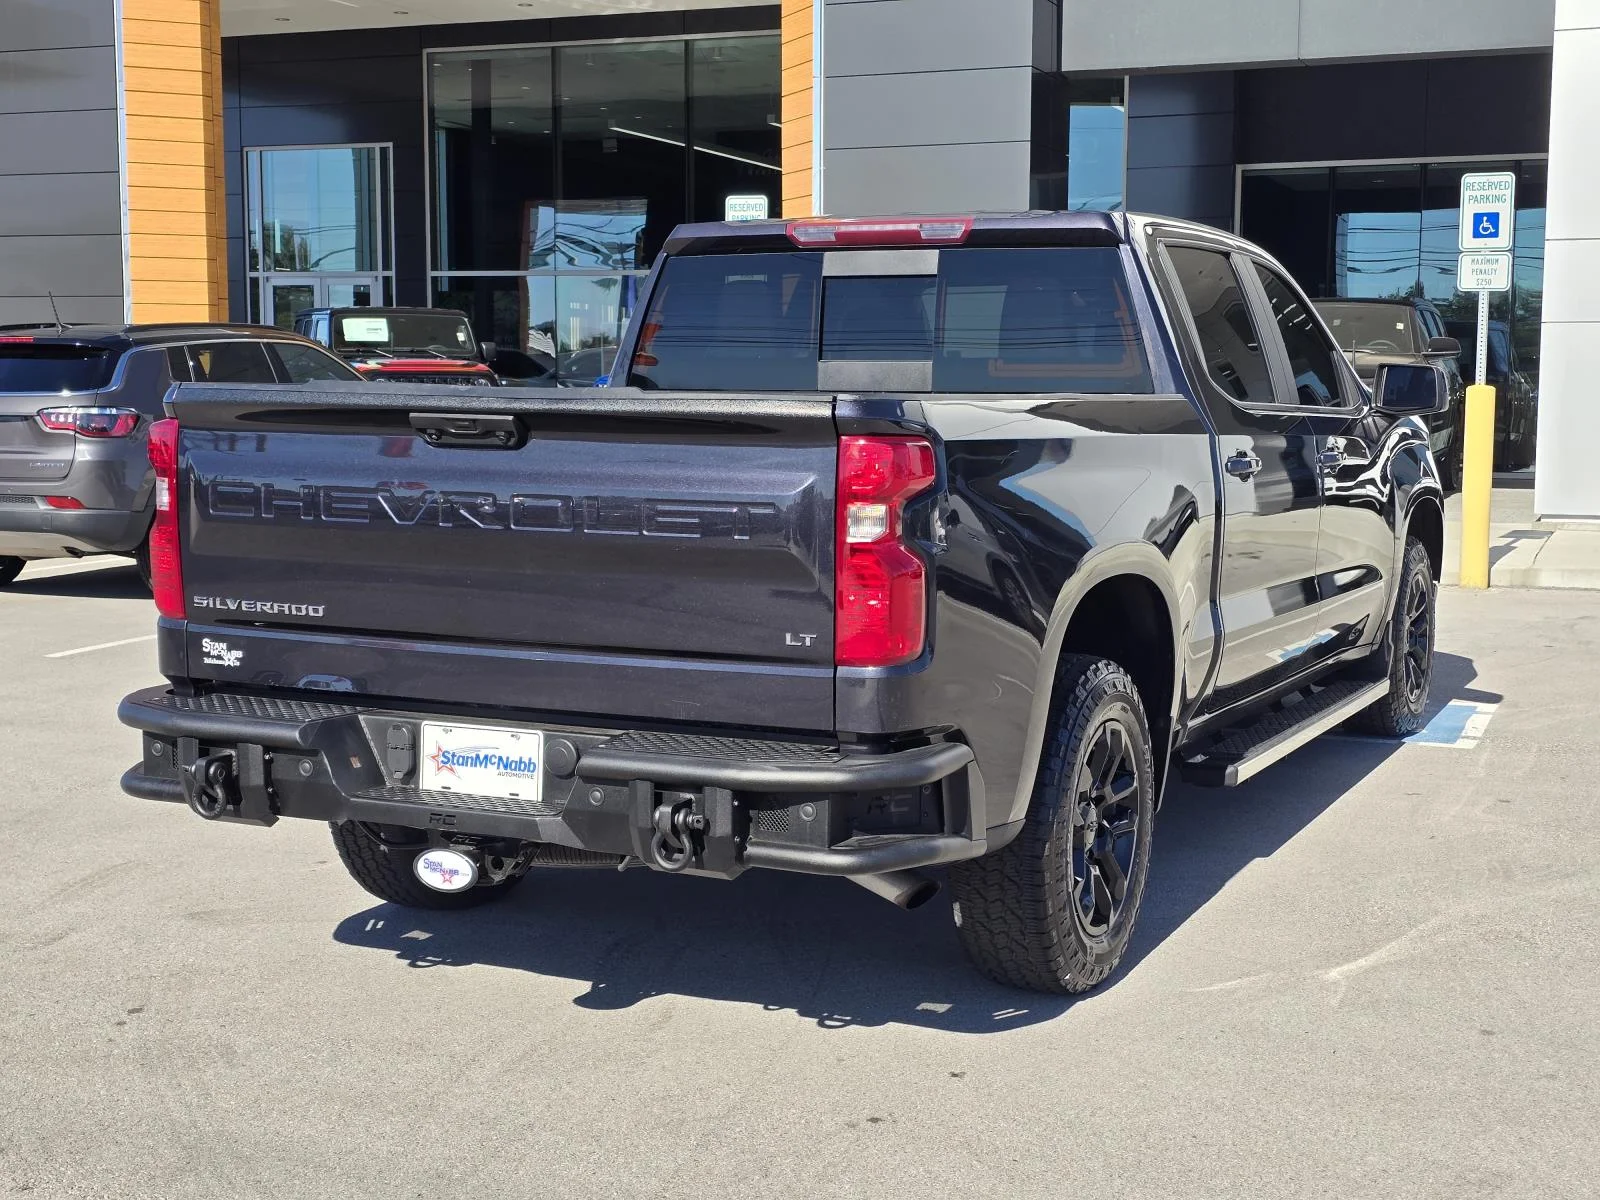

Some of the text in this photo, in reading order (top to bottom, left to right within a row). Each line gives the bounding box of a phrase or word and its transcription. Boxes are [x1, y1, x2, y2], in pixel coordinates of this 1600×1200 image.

[1465, 181, 1510, 191] RESERVED
[1468, 194, 1507, 204] PARKING
[729, 203, 764, 211] RESERVED
[1470, 257, 1500, 265] MAXIMUM
[208, 480, 776, 540] CHEVROLET
[193, 595, 325, 617] SILVERADO
[785, 632, 817, 647] LT
[497, 771, 535, 779] AUTOMOTIVE
